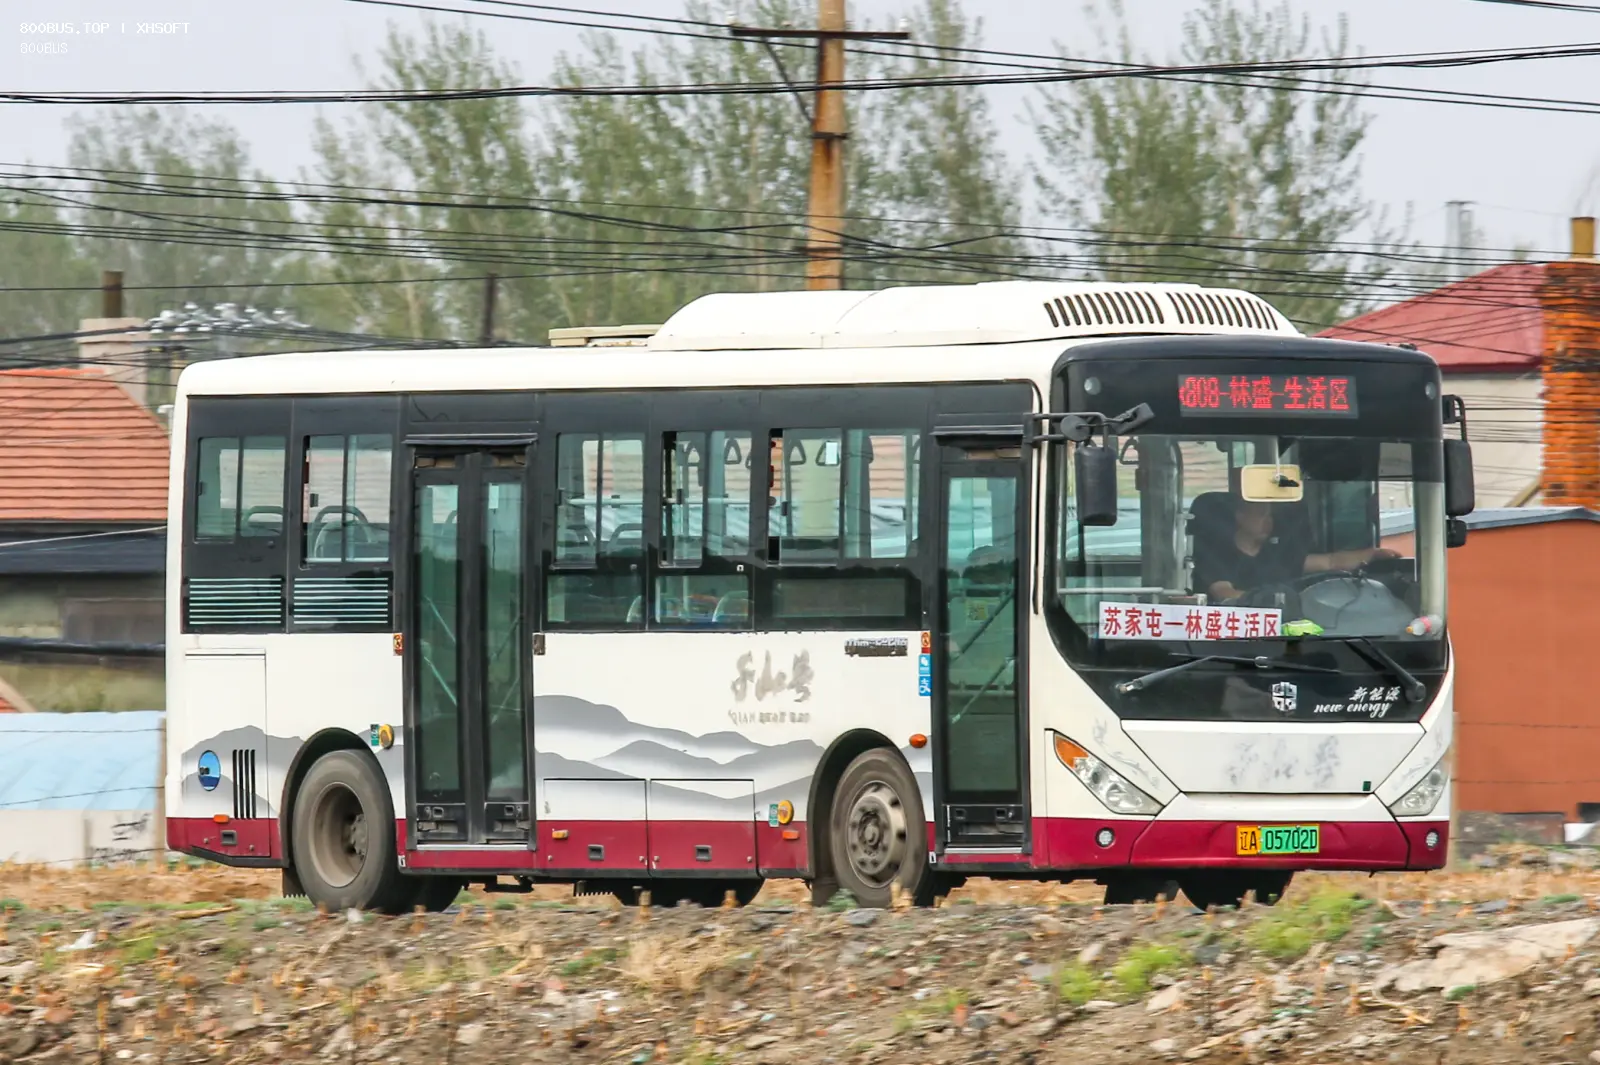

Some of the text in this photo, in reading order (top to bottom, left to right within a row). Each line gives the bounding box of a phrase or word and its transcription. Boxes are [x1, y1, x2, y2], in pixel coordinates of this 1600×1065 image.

[1349, 686, 1400, 702] 新能源
[1313, 702, 1392, 718] new energy
